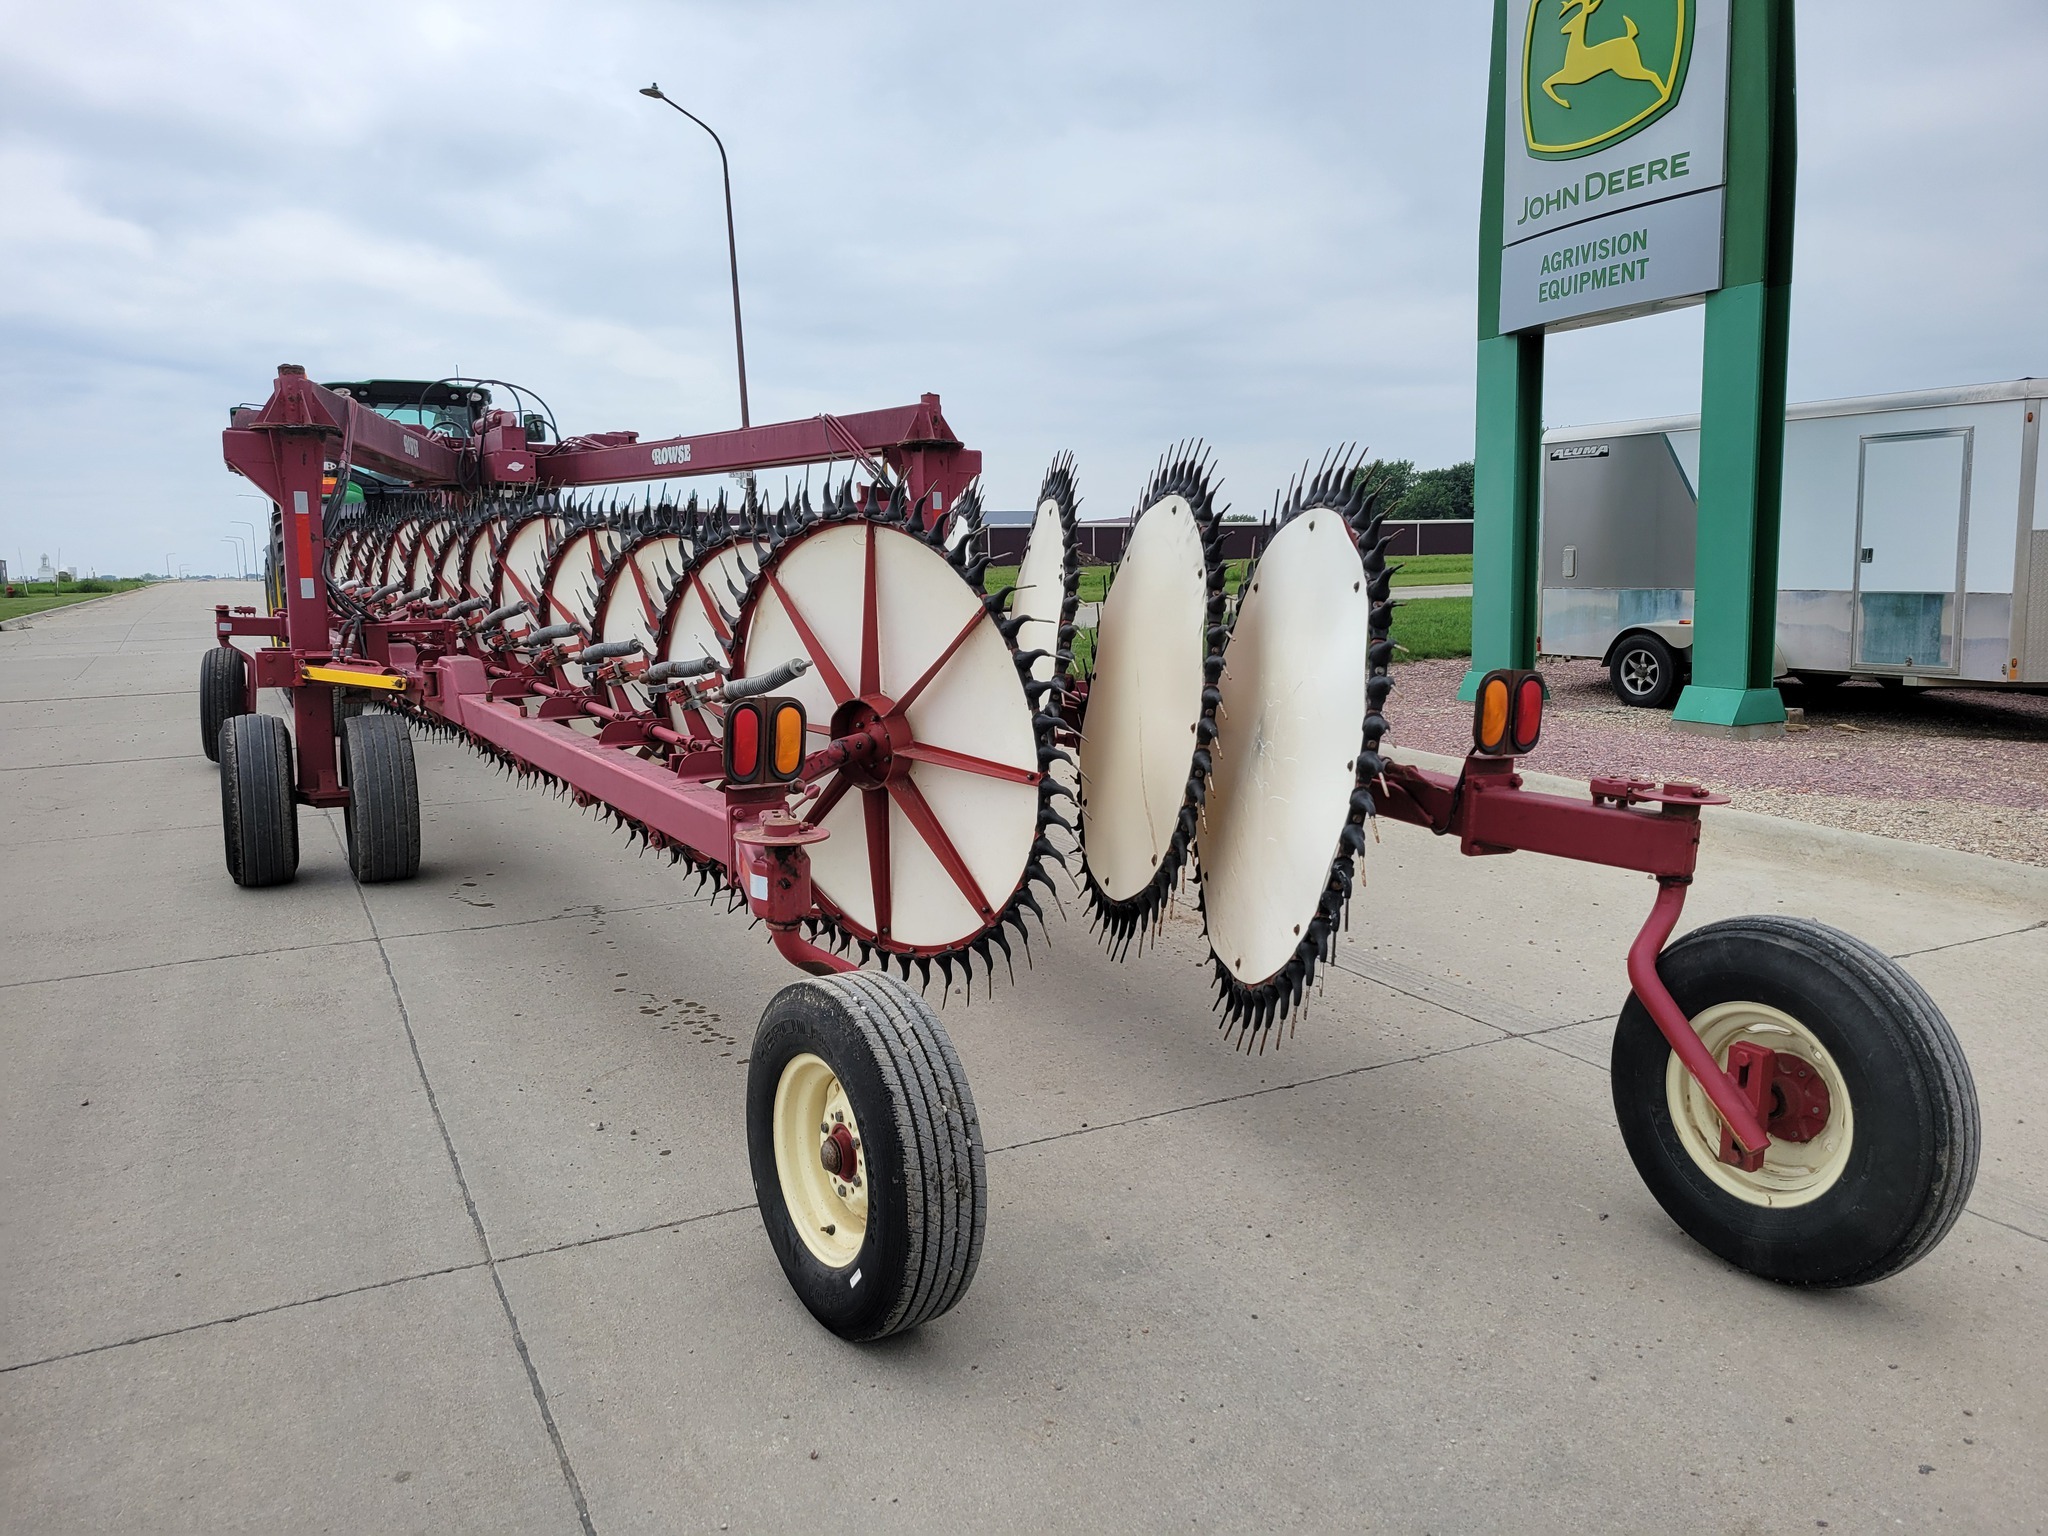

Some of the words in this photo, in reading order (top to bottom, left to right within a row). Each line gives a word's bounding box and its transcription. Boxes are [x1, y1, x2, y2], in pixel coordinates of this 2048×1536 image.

[1517, 183, 1580, 226] JOHN
[1584, 151, 1691, 203] DEERE
[1540, 228, 1648, 276] AGRIVISION
[1538, 257, 1650, 304] EQUIPMENT
[651, 443, 691, 466] ROWSE
[1552, 445, 1608, 459] ALUMA
